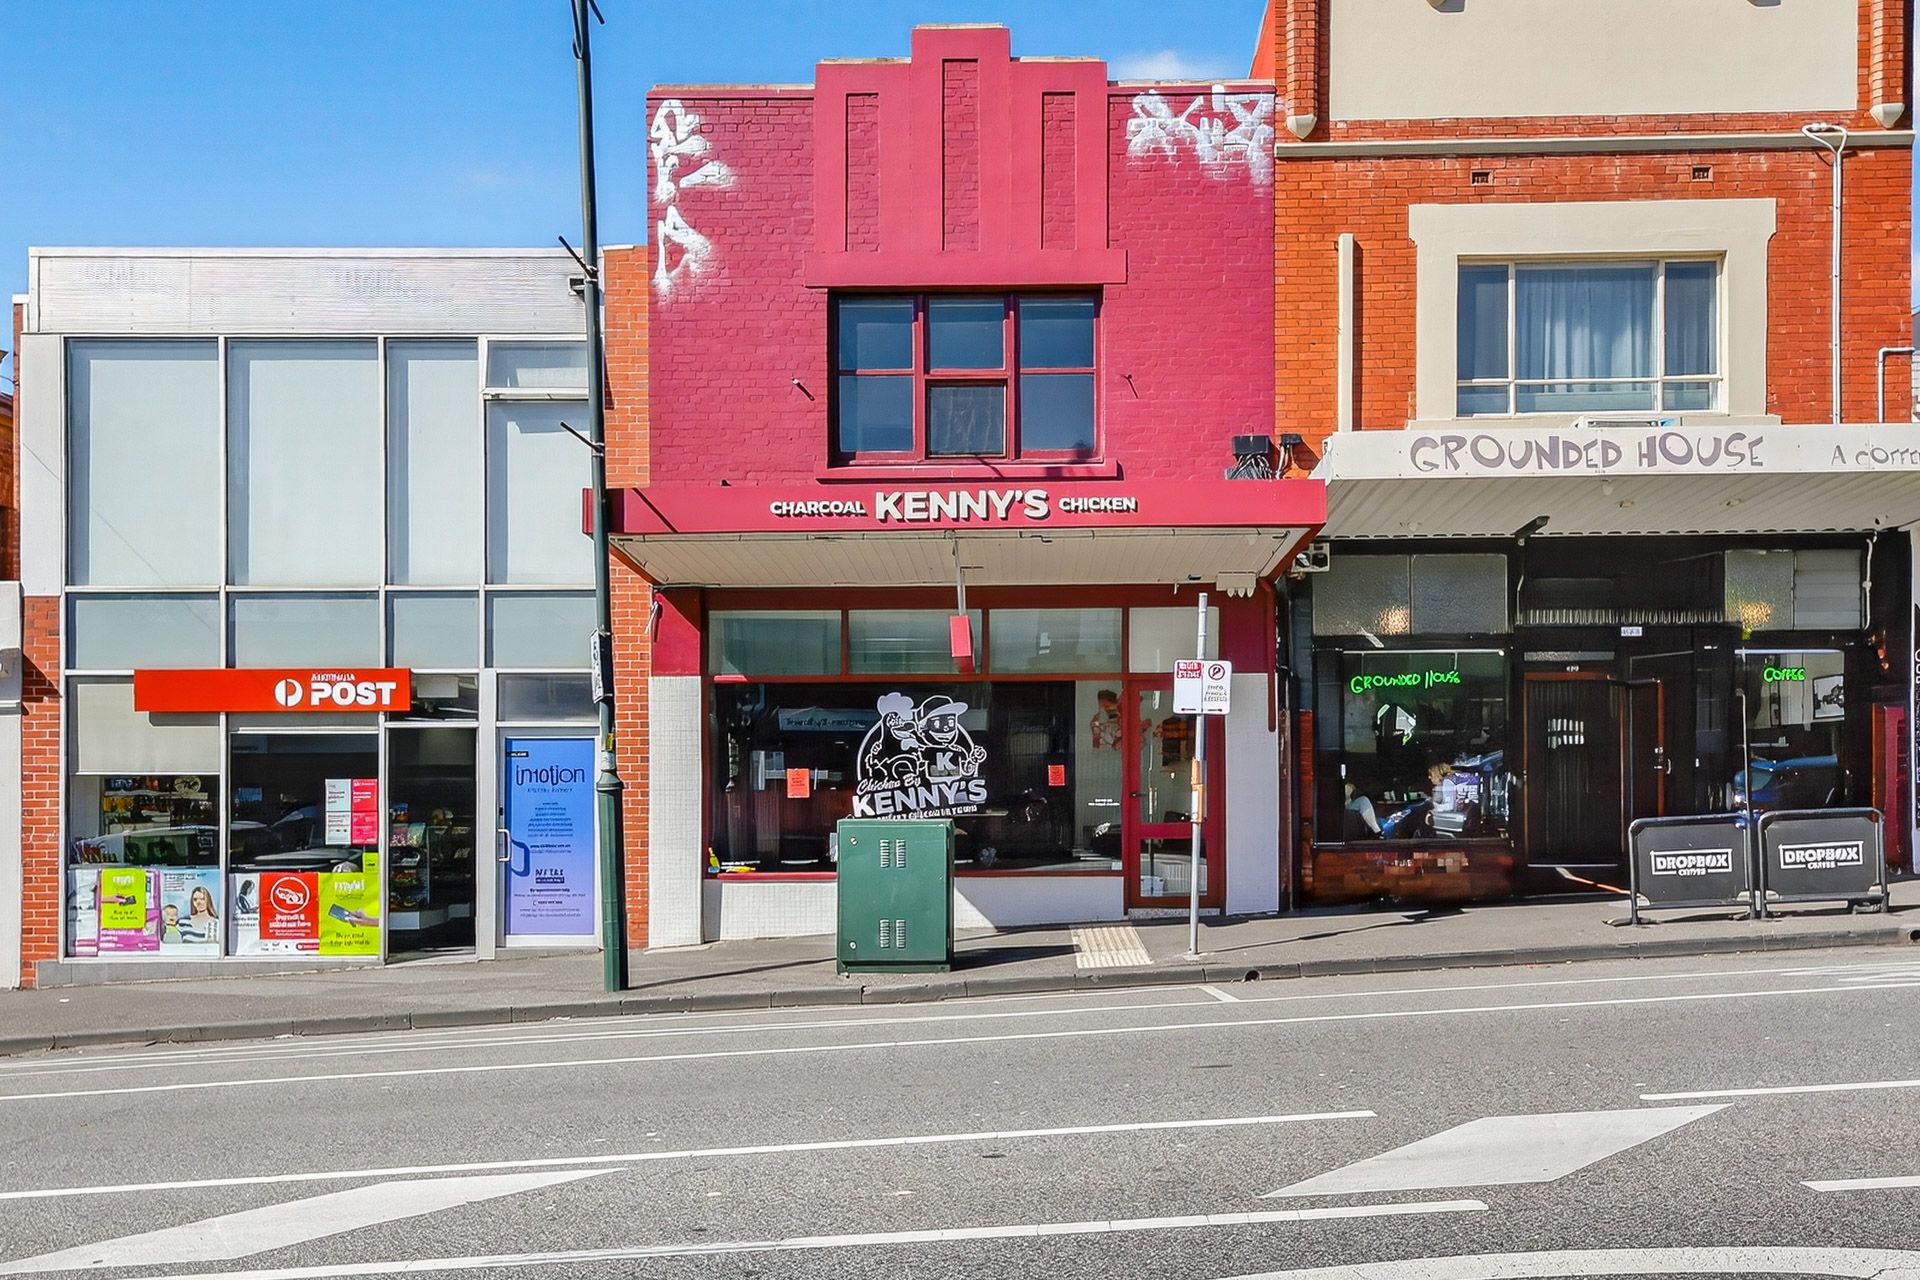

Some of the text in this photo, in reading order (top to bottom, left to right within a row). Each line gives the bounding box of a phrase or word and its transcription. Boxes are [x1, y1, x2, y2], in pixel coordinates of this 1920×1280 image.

[1410, 432, 1764, 471] GROUNDED HOUSE
[1831, 444, 1920, 465] A COFFE
[769, 490, 1139, 523] CHARCOAL KENNY'S CHICKEN
[1350, 673, 1421, 693] GROUNDED
[311, 682, 397, 706] POST
[935, 751, 956, 771] K
[852, 779, 988, 818] KENNY'S
[1656, 854, 1729, 870] DROPBOX
[1785, 847, 1859, 864] DROPBOX
